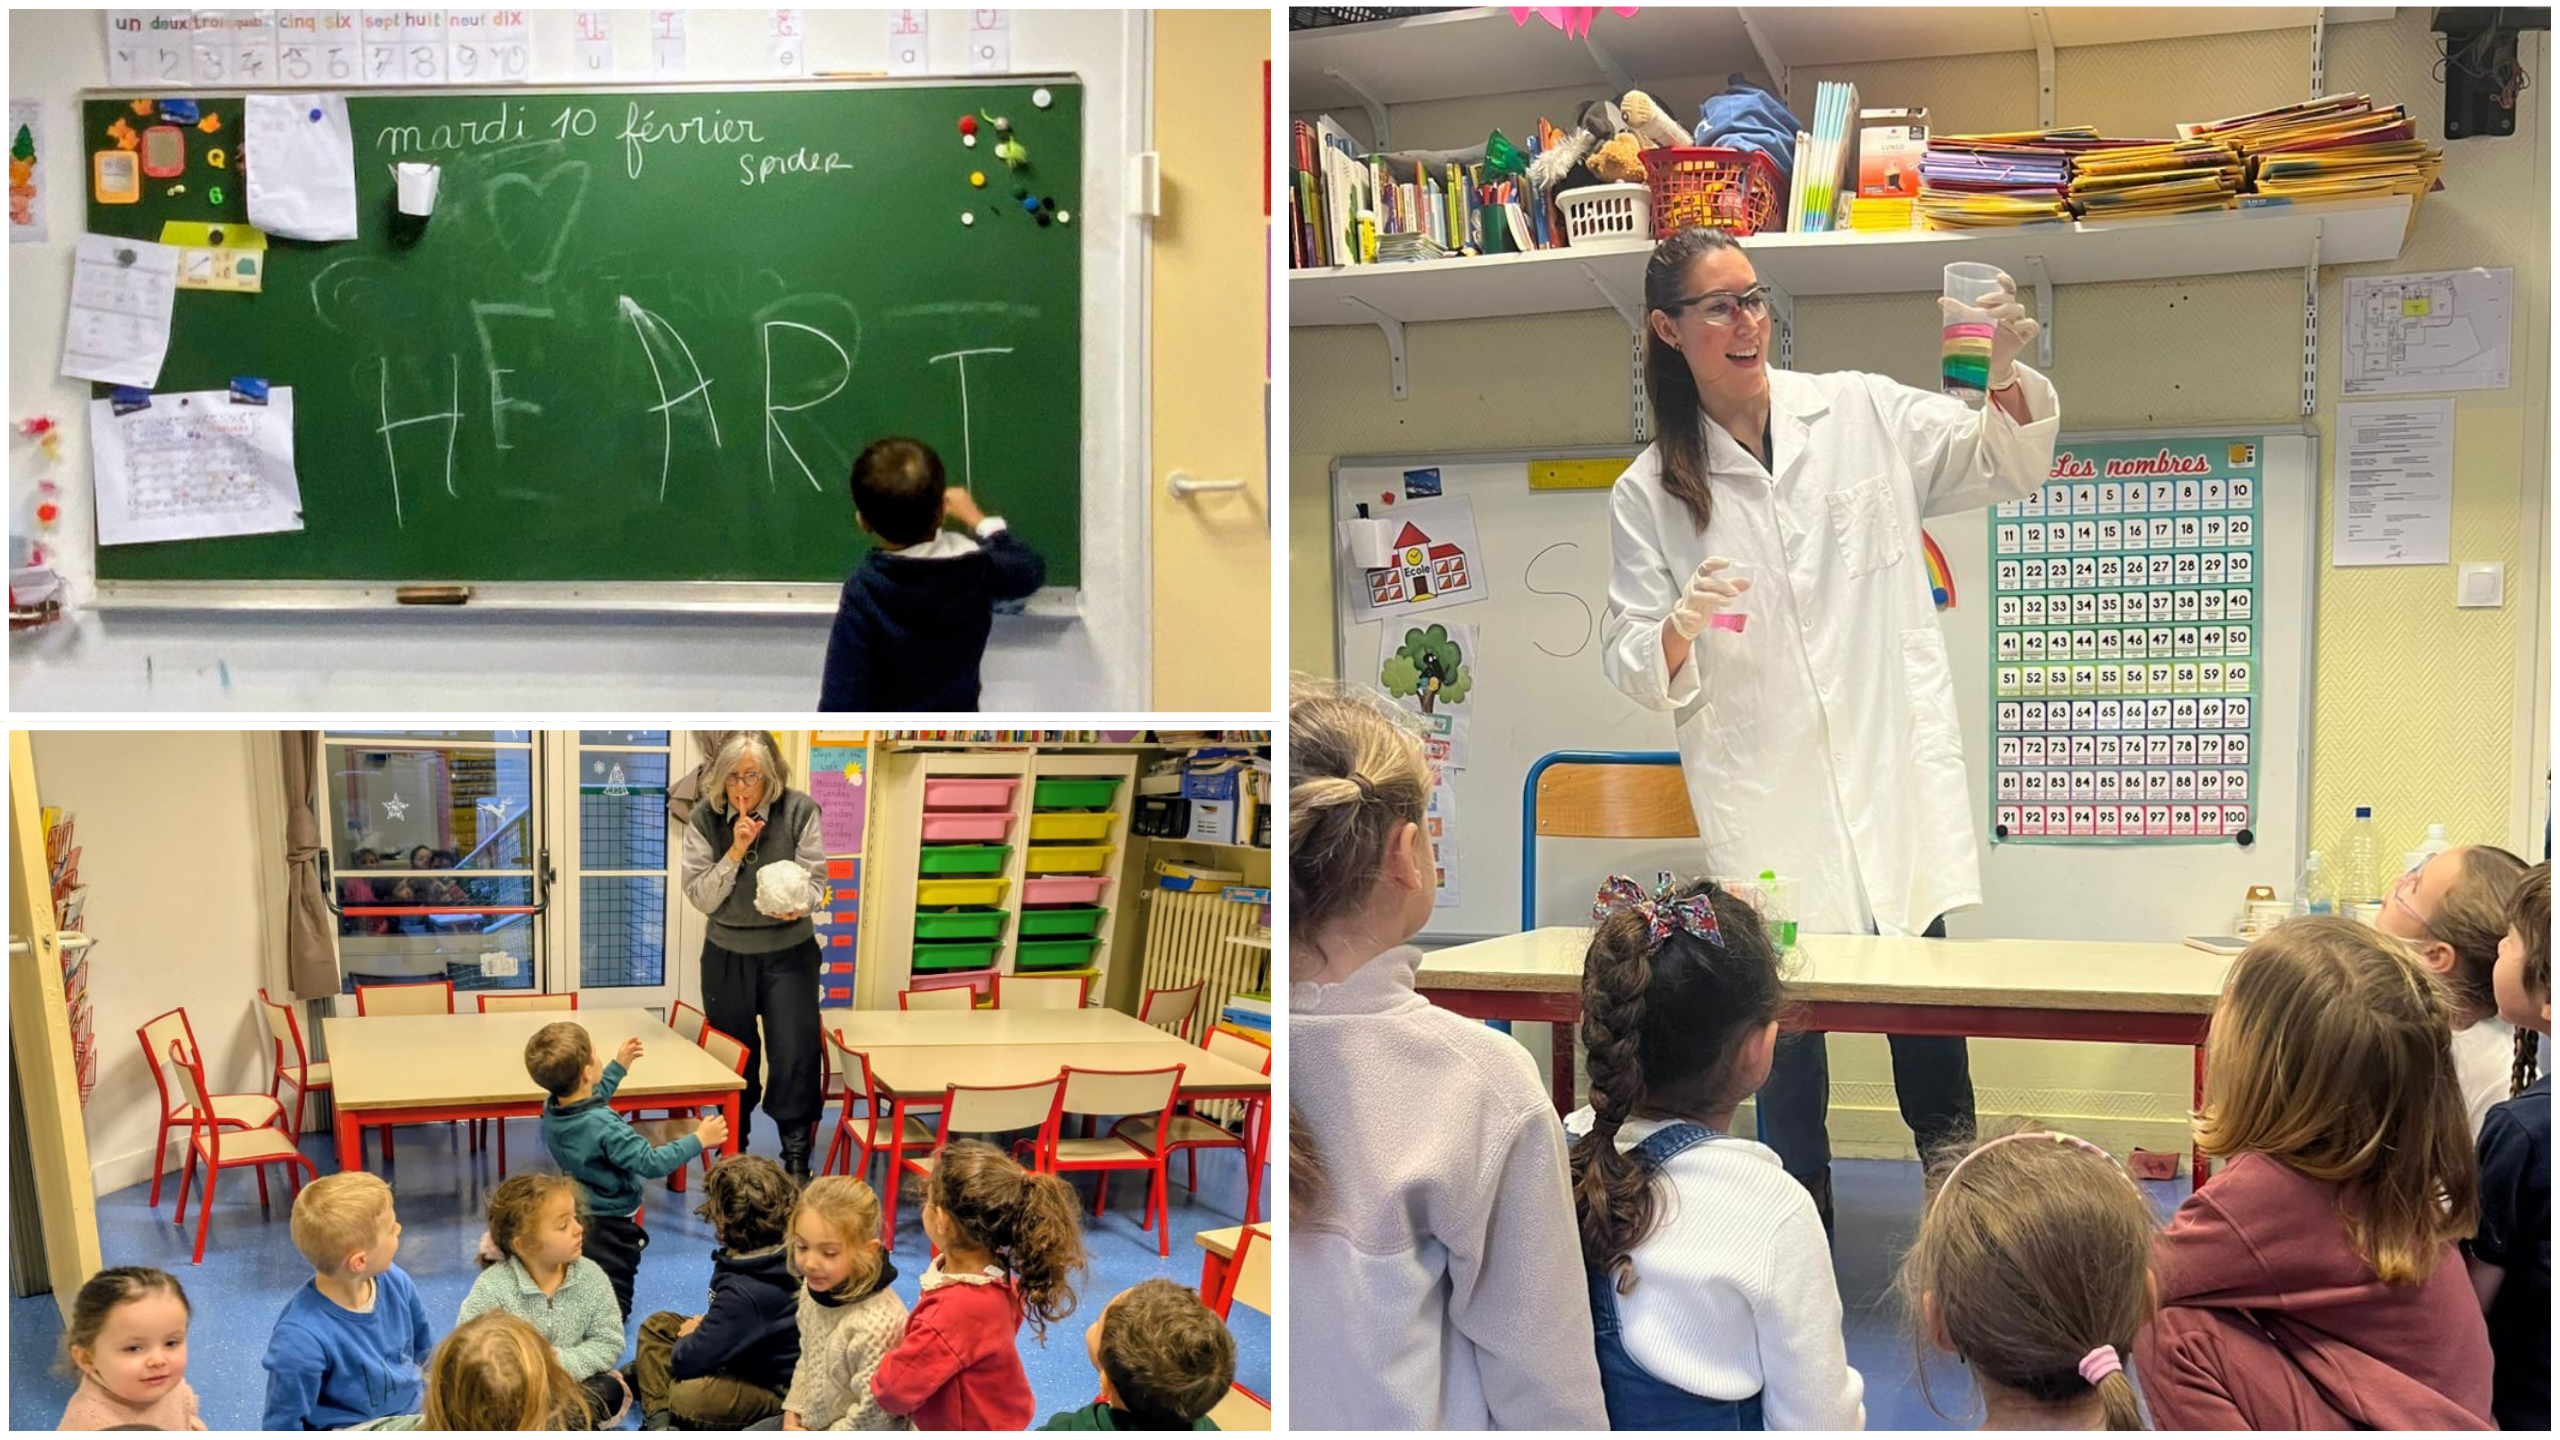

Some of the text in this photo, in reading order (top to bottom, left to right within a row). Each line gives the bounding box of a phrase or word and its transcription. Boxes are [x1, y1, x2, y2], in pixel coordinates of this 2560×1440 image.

[115, 17, 141, 31] un
[150, 16, 188, 30] deux
[279, 16, 315, 32] cinq
[323, 12, 351, 29] six
[365, 14, 399, 31] sept
[405, 12, 441, 27] huit
[450, 13, 485, 27] neuf
[160, 49, 179, 80] 2
[202, 51, 224, 81] 3
[410, 46, 435, 78] 8
[457, 44, 477, 77] 9
[780, 50, 794, 66] e
[901, 49, 915, 64] a
[376, 101, 765, 180] mardi 10 février
[2049, 448, 2210, 478] Les nombres
[2030, 484, 2247, 504] 2 3 4 5 6 7 8 9 10
[2004, 521, 2249, 541] 11 12 13 14 15 16 17 18 19 20
[2003, 558, 2248, 578] 21 22 23 24 25 26 27 28 29 30
[2003, 595, 2248, 613] 31 32 33 34 35 36 37 38 39 40
[2004, 632, 2247, 649] 41 42 43 44 45 46 47 48 49 50
[2004, 668, 2246, 684] 51 52 53 54 55 56 57 58 59 60
[2003, 704, 2246, 719] 61 62 63 64 65 66 67 68 69 70
[2003, 740, 2244, 754] 71 72 73 74 75 76 77 78 79 80
[2003, 776, 2244, 788] 81 82 83 84 85 86 87 88 89 90
[2003, 811, 2245, 823] 91 92 93 94 95 96 97 98 99 100
